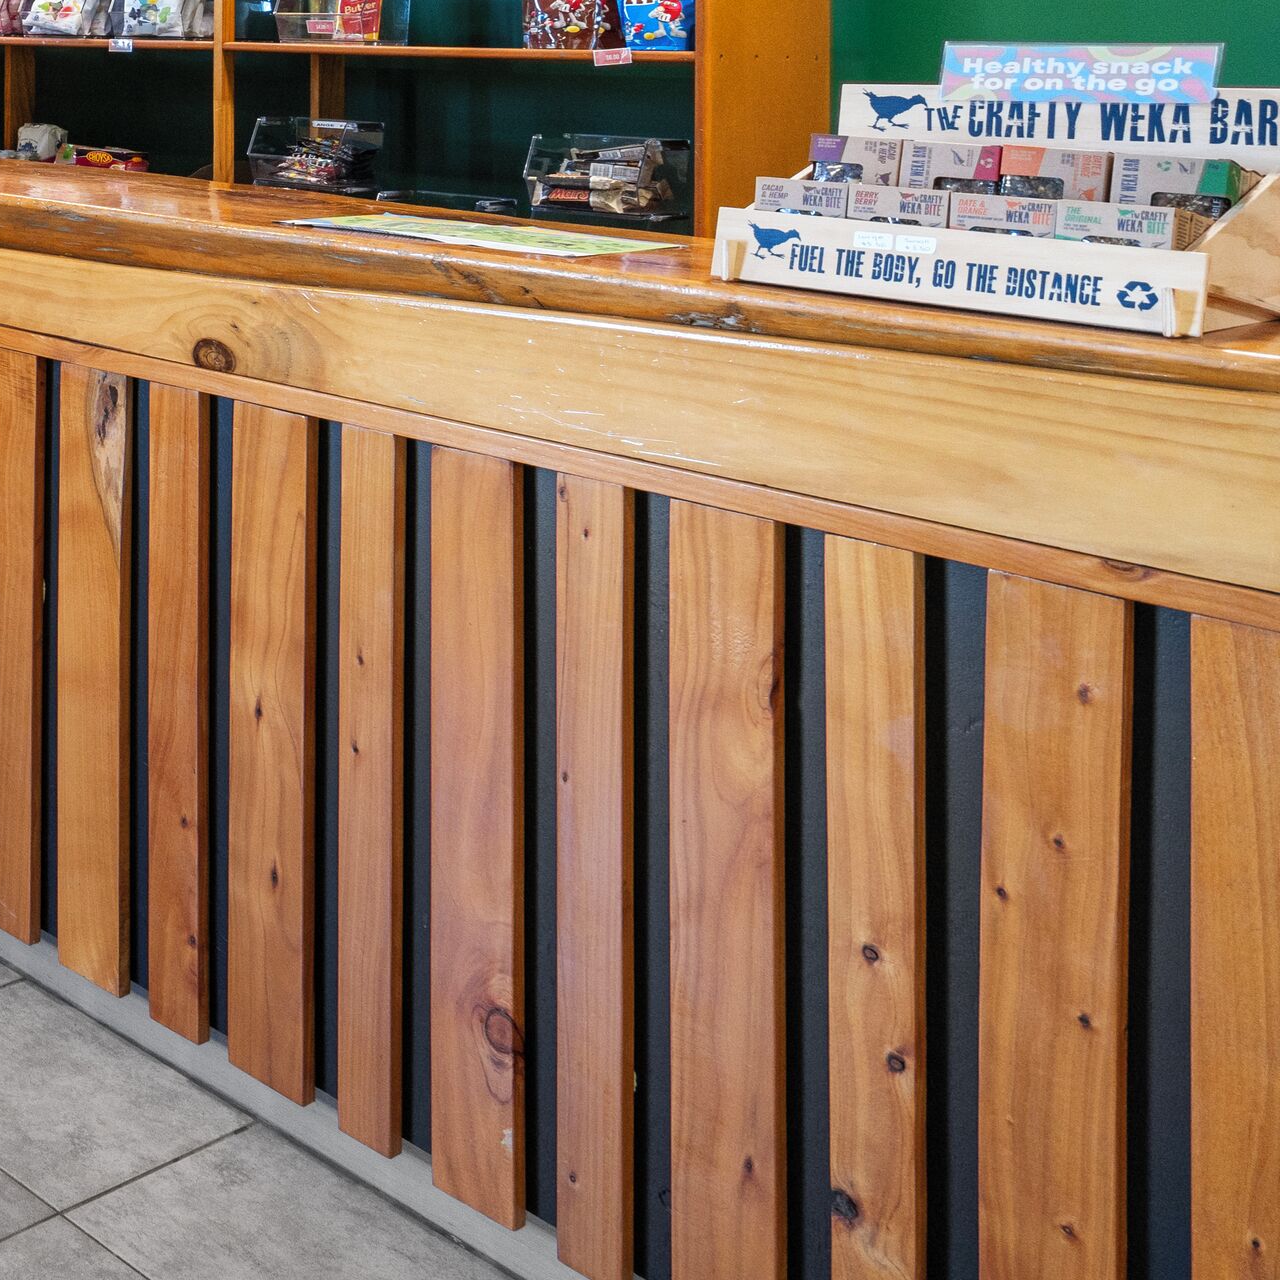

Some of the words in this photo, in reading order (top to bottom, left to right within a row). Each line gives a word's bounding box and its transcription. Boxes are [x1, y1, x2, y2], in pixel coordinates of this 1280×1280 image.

[344, 1, 377, 15] Butter
[963, 57, 1087, 79] Healthy
[1089, 56, 1194, 75] snack
[971, 73, 1017, 92] for
[1023, 77, 1068, 91] on
[1072, 74, 1130, 91] the
[1134, 78, 1179, 96] go
[924, 105, 964, 132] THE
[967, 99, 1083, 141] CRAFTY
[1100, 102, 1190, 145] WEKA
[1208, 99, 1279, 147] BAR
[761, 184, 784, 192] CACAO
[821, 186, 844, 198] CRAFTY
[548, 188, 590, 202] Mars
[768, 192, 789, 200] HEMP
[802, 193, 823, 208] WEKA
[825, 196, 842, 209] BITE
[919, 194, 944, 205] CRAFTY
[854, 197, 878, 207] BERRY
[899, 200, 922, 215] WEKA
[924, 203, 942, 217] BITE
[958, 199, 978, 208] DATE
[1027, 202, 1052, 214] CRAFTY
[957, 206, 988, 216] ORANGE
[1066, 206, 1082, 215] THE
[1140, 210, 1168, 223] CRAFTY
[1006, 210, 1030, 224] WEKA
[1032, 212, 1052, 226] BITE
[1064, 214, 1102, 225] ORIGINAL
[1117, 218, 1143, 233] WEKA
[1146, 219, 1168, 235] BITE
[789, 242, 826, 275] FUEL
[835, 247, 865, 279] THE
[871, 252, 922, 289] BODY,
[931, 258, 957, 290] GO
[965, 262, 999, 295] THE
[1004, 266, 1104, 307] DISTANCE
